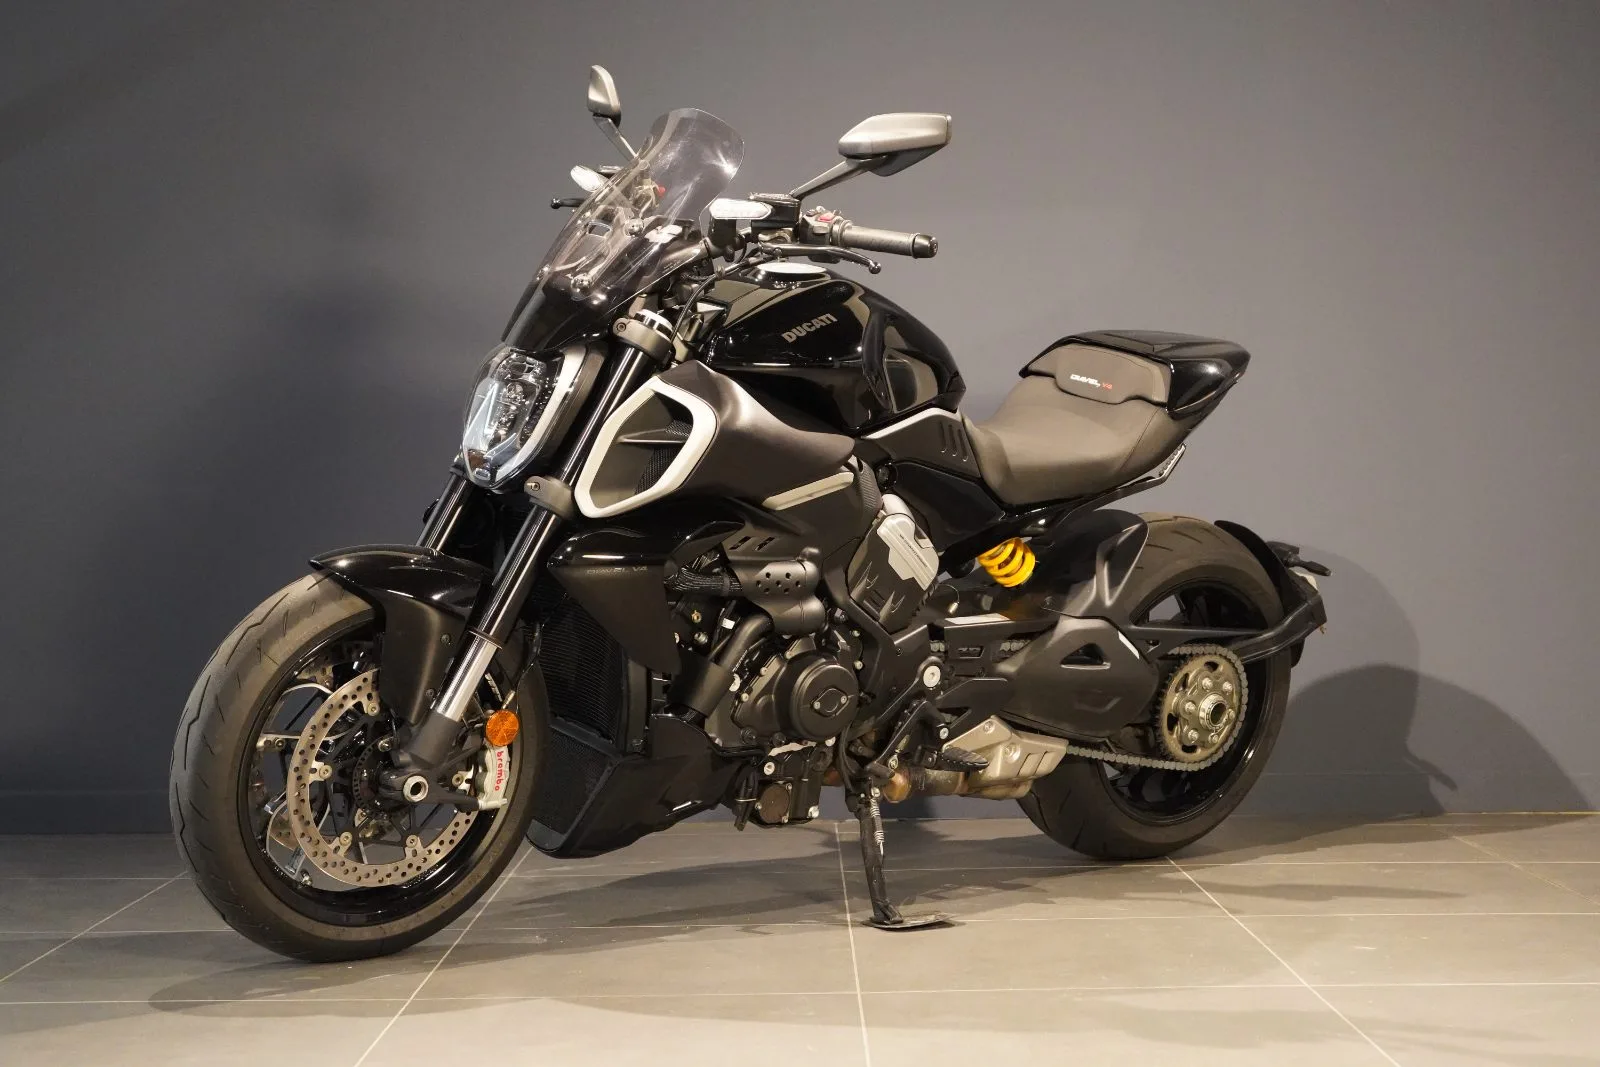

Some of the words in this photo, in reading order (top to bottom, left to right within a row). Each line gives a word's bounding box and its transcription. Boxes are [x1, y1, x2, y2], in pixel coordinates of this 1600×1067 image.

[781, 313, 838, 343] DUCATI
[632, 565, 649, 573] V4
[494, 750, 505, 792] brembo
